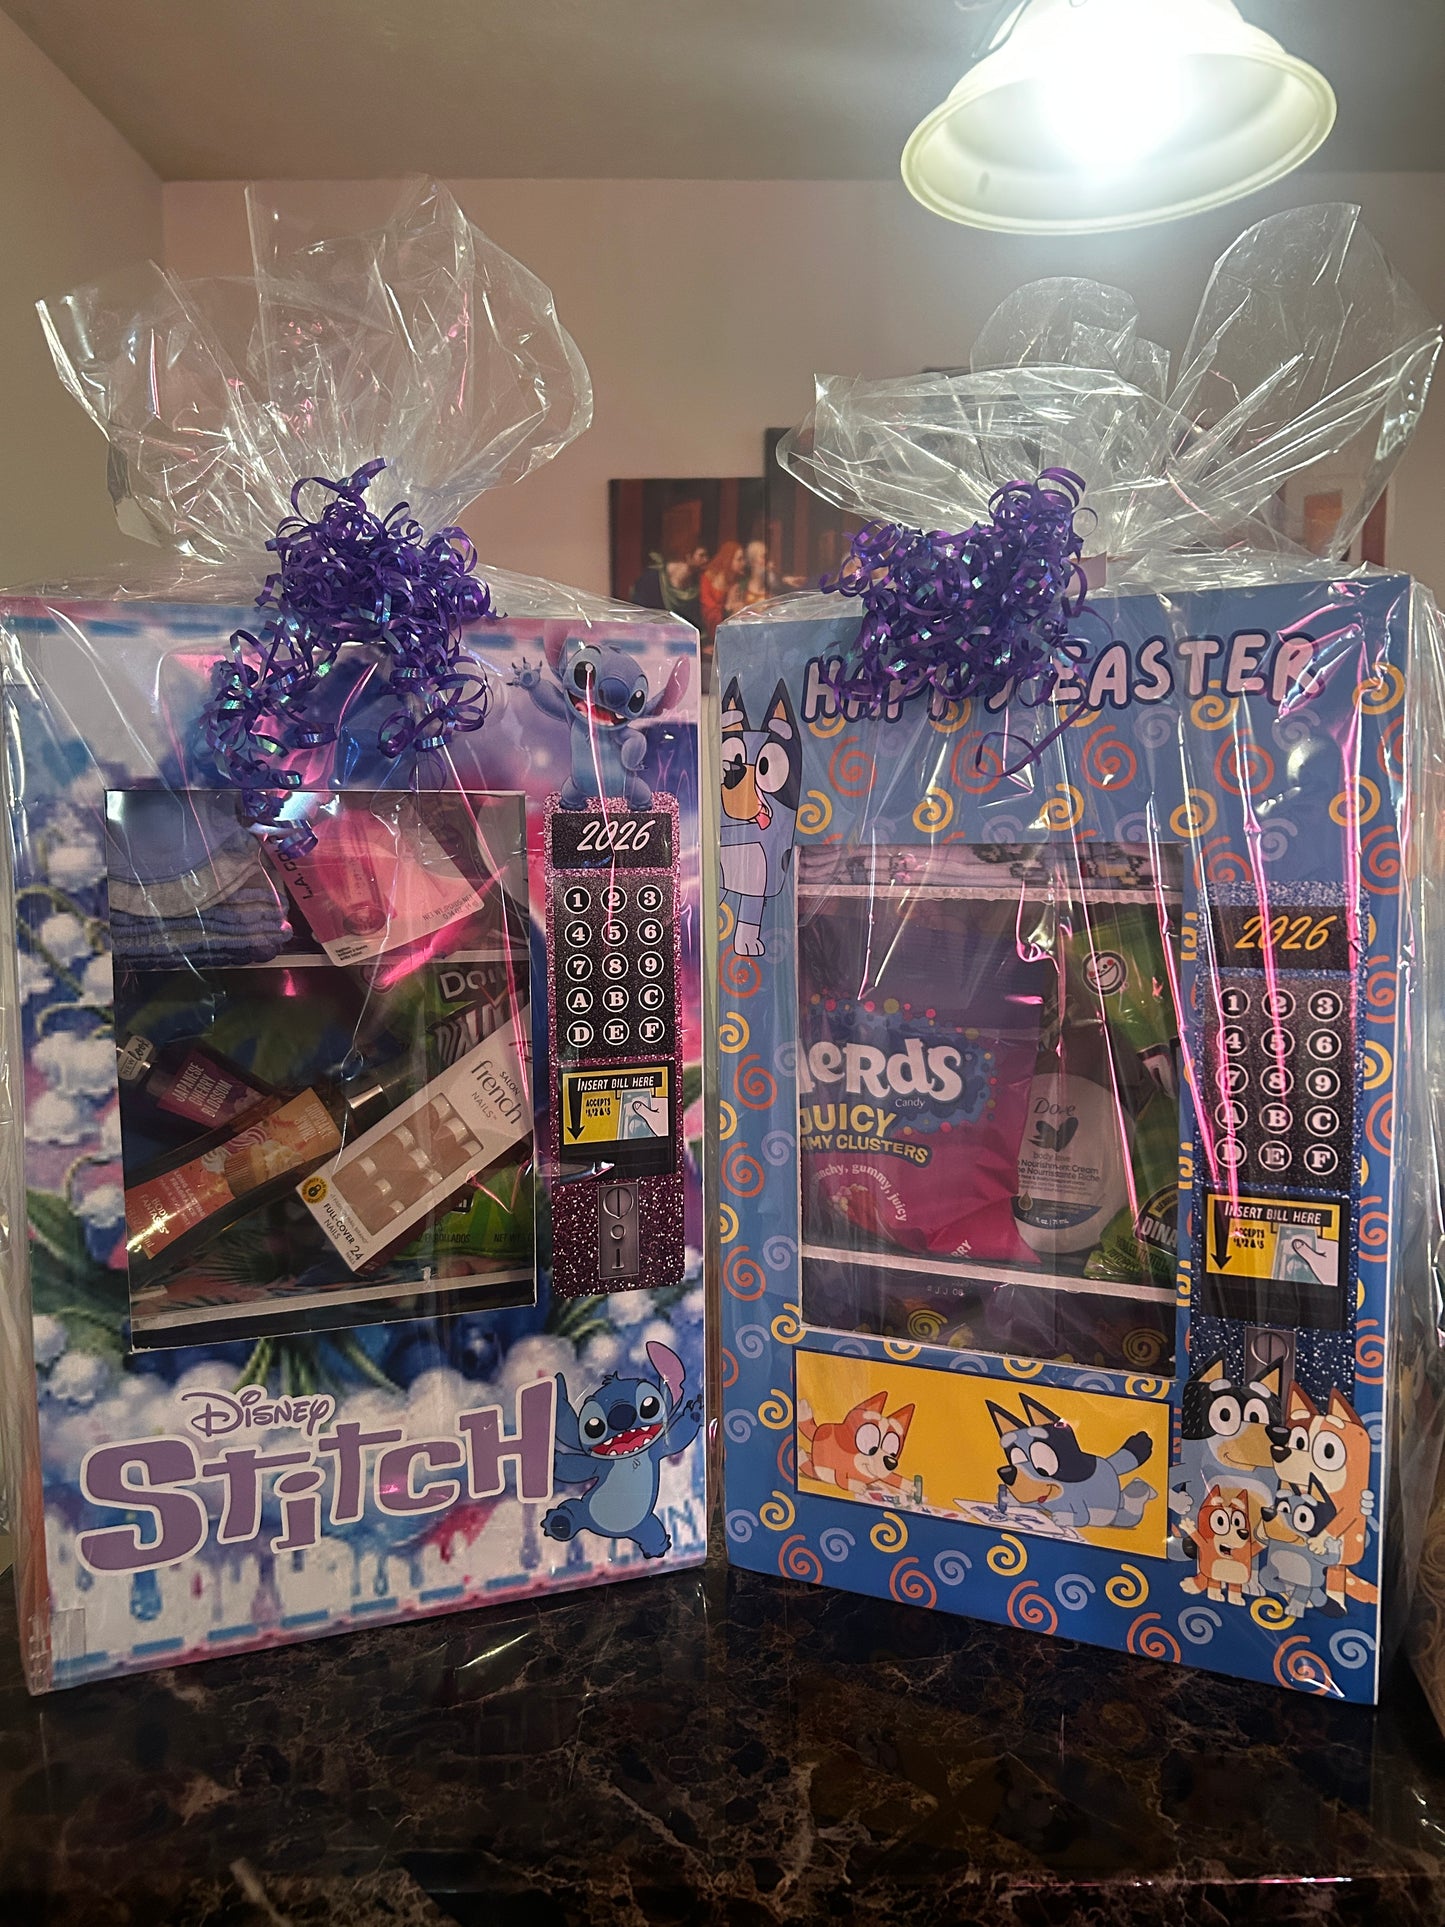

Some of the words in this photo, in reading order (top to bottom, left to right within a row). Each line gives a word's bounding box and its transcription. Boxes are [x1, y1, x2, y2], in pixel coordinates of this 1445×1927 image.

[1051, 628, 1322, 711] EASTER
[577, 820, 656, 851] 2026
[573, 893, 583, 908] 1
[607, 892, 621, 907] 2
[644, 891, 656, 905] 3
[572, 927, 585, 941] 4
[608, 926, 621, 940] 5
[644, 925, 656, 939] 6
[1234, 915, 1338, 951] 2026
[573, 961, 586, 975] 7
[609, 959, 622, 973] 8
[644, 957, 656, 972] 9
[572, 993, 588, 1008] A
[609, 991, 624, 1007] B
[644, 990, 659, 1005] C
[1228, 995, 1240, 1011] 1
[1272, 996, 1287, 1012] 2
[1316, 997, 1333, 1014] 3
[573, 1027, 590, 1042] D
[609, 1025, 624, 1040] E
[645, 1023, 660, 1038] F
[1225, 1032, 1241, 1049] 4
[1270, 1035, 1286, 1051] 5
[1316, 1036, 1332, 1053] 6
[172, 1062, 205, 1103] JAPANESE
[188, 1074, 216, 1106] CHERRY
[471, 1060, 522, 1125] french
[500, 1071, 520, 1096] SALON
[577, 1078, 609, 1092] INSERT
[611, 1076, 629, 1089] BILL
[632, 1075, 655, 1087] HERE
[1269, 1072, 1285, 1088] 8
[1315, 1074, 1332, 1092] 9
[201, 1079, 233, 1118] BLOSSOM
[895, 1098, 926, 1108] Candy
[1221, 1107, 1242, 1124] A
[1268, 1109, 1287, 1126] B
[1312, 1112, 1331, 1130] C
[836, 1135, 929, 1164] CLUSTERS
[1267, 1148, 1285, 1165] E
[1312, 1150, 1331, 1167] F
[1072, 1165, 1099, 1175] Cream
[852, 1163, 891, 1194] gummy,
[887, 1192, 907, 1222] juicy
[141, 1194, 168, 1234] FANTASES
[323, 1202, 355, 1245] FULL-COVER
[1224, 1202, 1263, 1219] INSERT
[1267, 1209, 1289, 1222] BILL
[1293, 1210, 1322, 1225] HERE
[324, 1219, 342, 1240] NAILS
[350, 1245, 364, 1260] 24
